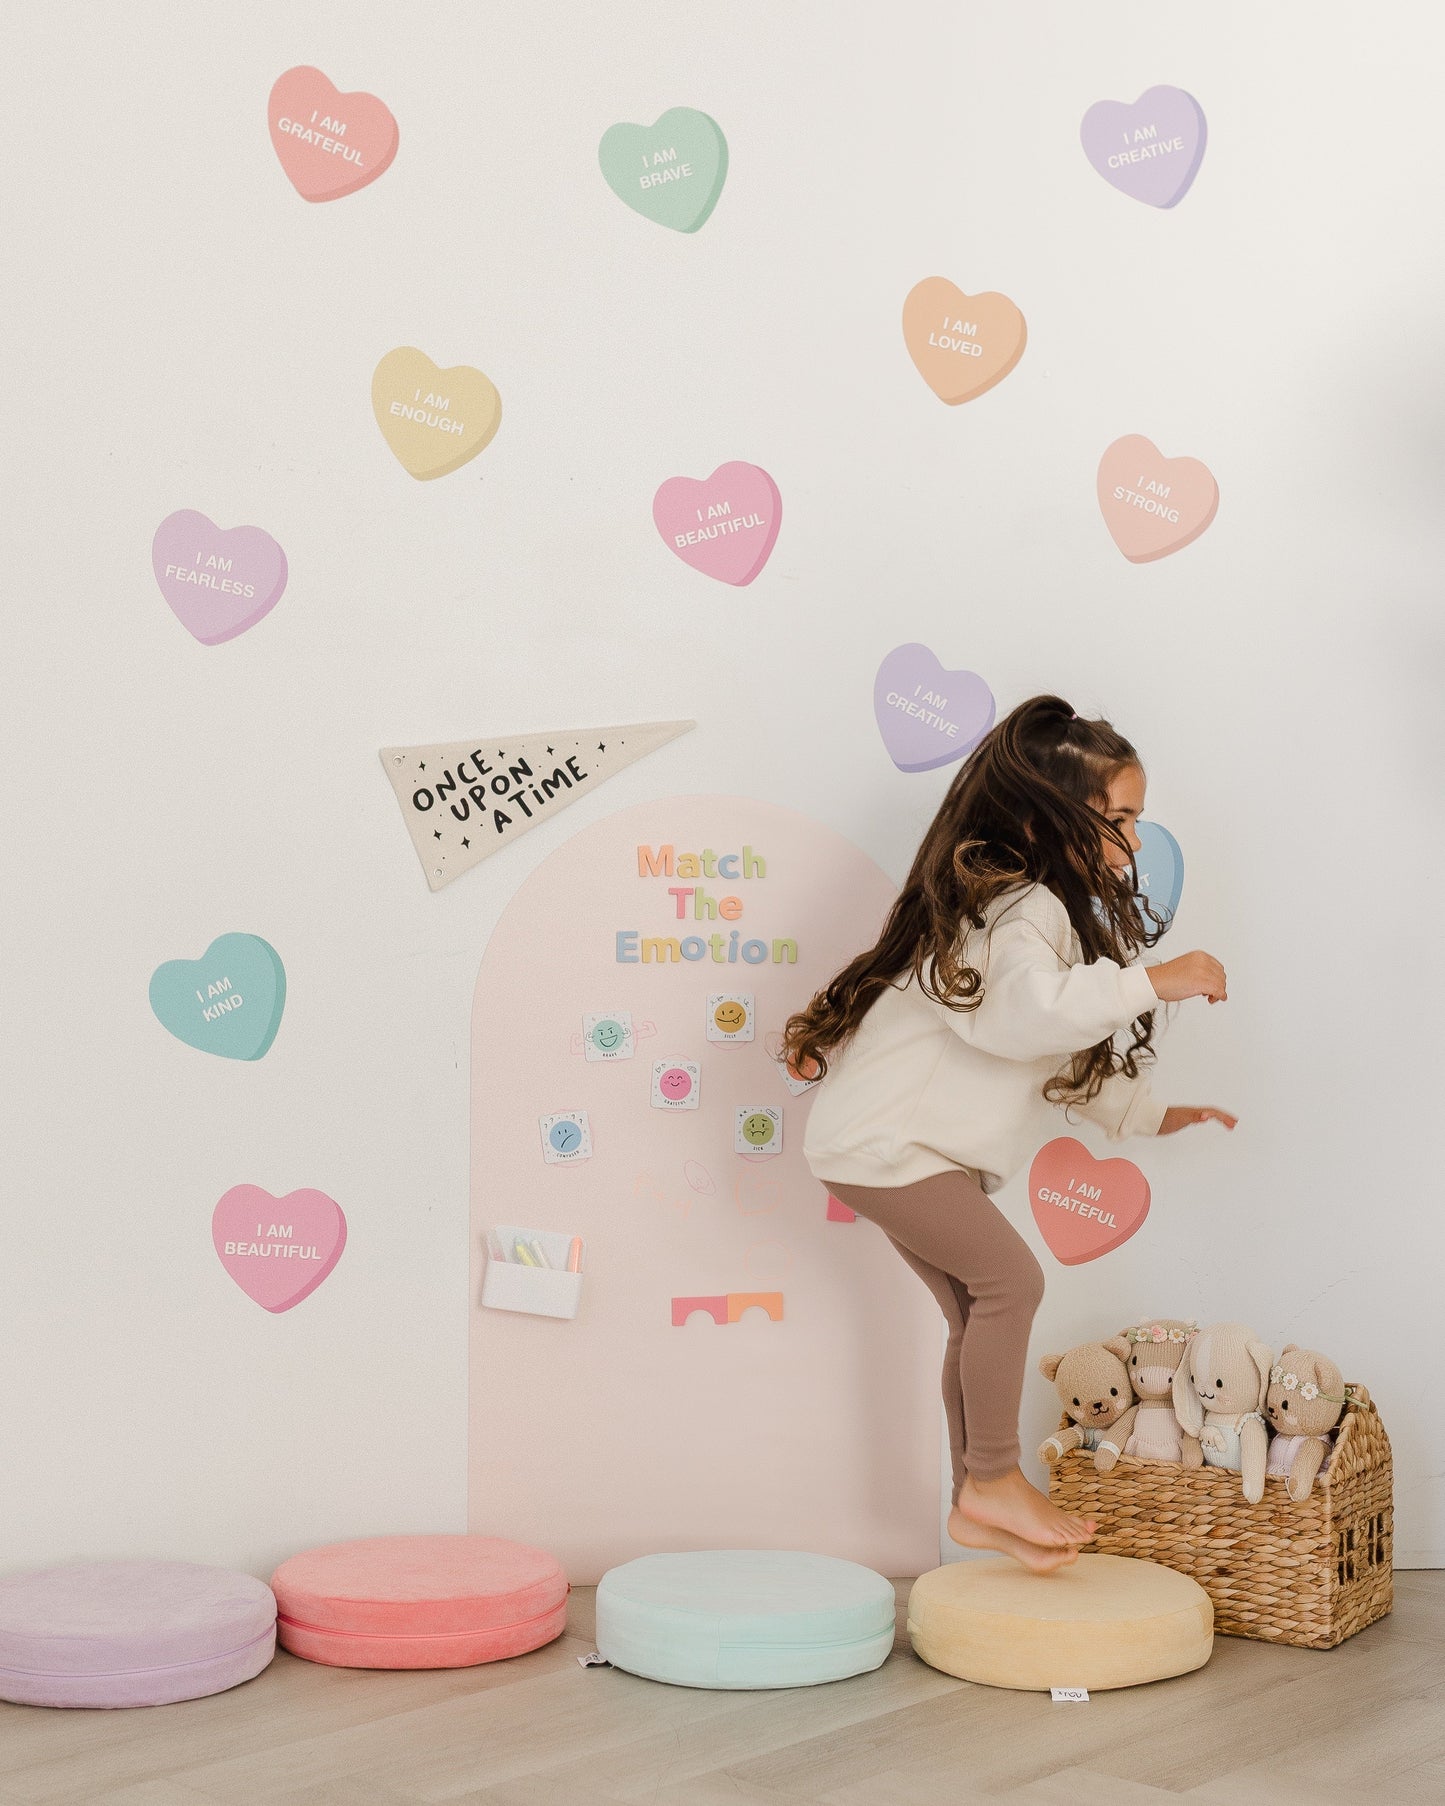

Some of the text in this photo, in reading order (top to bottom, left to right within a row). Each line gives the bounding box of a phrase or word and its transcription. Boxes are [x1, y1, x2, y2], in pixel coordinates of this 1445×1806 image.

[310, 110, 347, 137] I AM
[1123, 124, 1157, 145] I AM
[278, 117, 364, 167] GRATEFUL
[1107, 136, 1185, 169] CREATIVE
[642, 147, 677, 168] I AM
[639, 163, 693, 189] BRAVE
[943, 317, 977, 337] I AM
[928, 332, 983, 357] LOVED
[415, 389, 450, 411] I AM
[389, 401, 465, 436] ENOUGH
[1137, 475, 1171, 499] I AM
[696, 501, 731, 522] I AM
[1113, 486, 1180, 523] STRONG
[674, 513, 765, 548] BEAUTIFUL
[196, 551, 233, 572] I AM
[165, 564, 255, 598] FEARLESS
[914, 685, 948, 711] I AM
[886, 691, 959, 738] CREATIVE
[412, 749, 493, 811] ONCE
[450, 757, 533, 821] UPON
[493, 809, 512, 833] A
[637, 845, 766, 879] Match
[668, 887, 743, 920] The
[616, 930, 797, 964] Emotion
[196, 976, 233, 1003] I AM
[202, 994, 243, 1022] KIND
[1067, 1178, 1102, 1201] I AM
[1037, 1187, 1117, 1229] GRATEFUL
[257, 1223, 293, 1239] I AM
[224, 1241, 321, 1260] BEAUTIFUL
